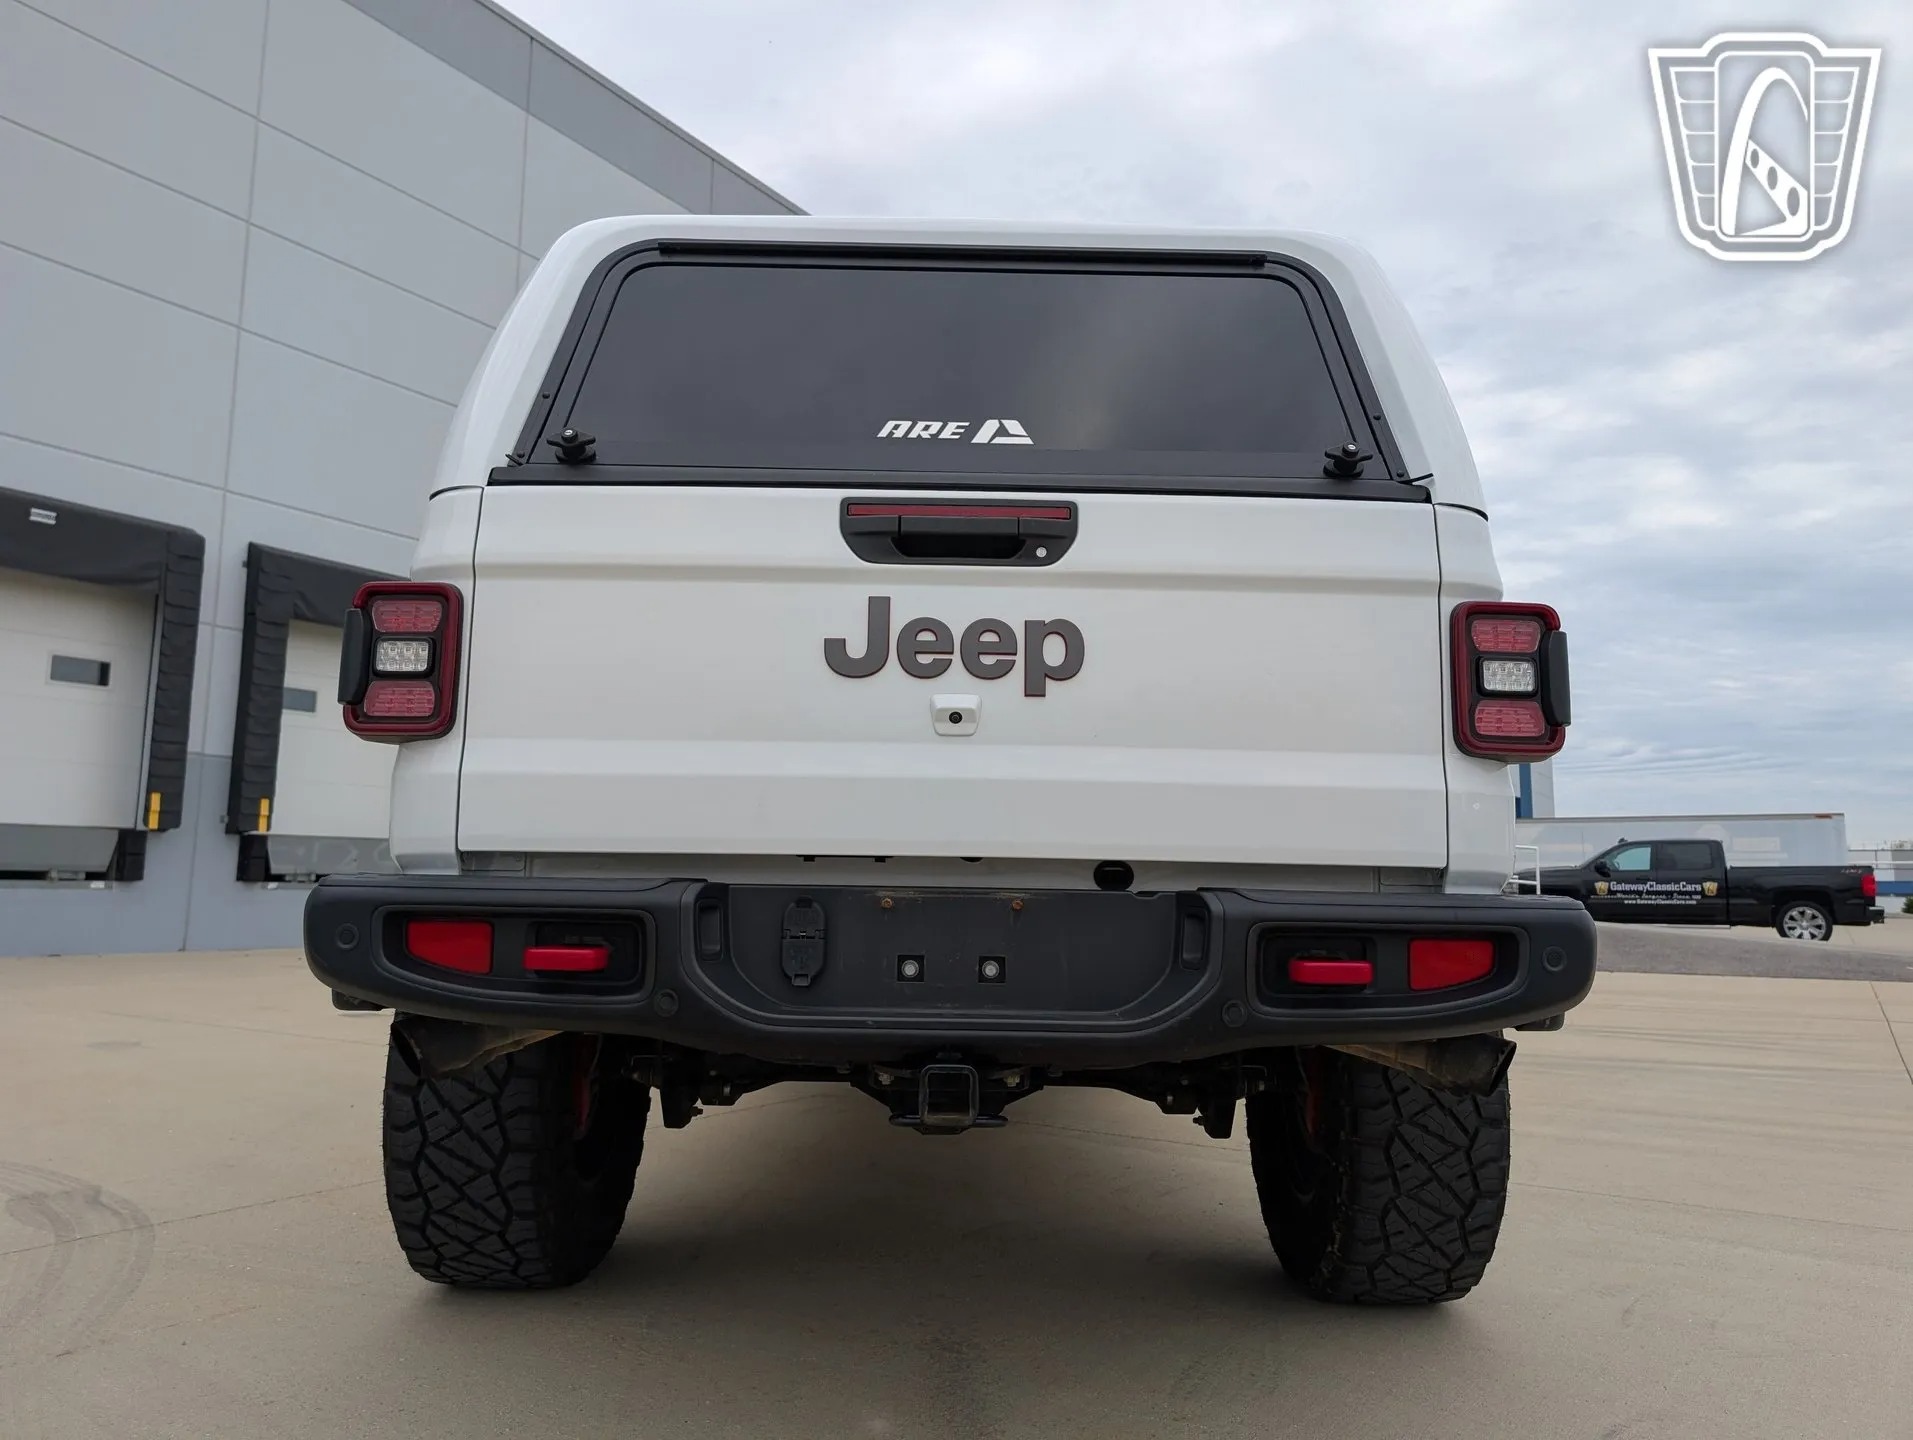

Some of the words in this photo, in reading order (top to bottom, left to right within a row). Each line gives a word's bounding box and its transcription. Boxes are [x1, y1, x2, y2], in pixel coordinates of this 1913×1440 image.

[876, 420, 970, 440] ARE
[823, 596, 1086, 698] Jeep
[1609, 881, 1702, 893] GatewayClassicCars
